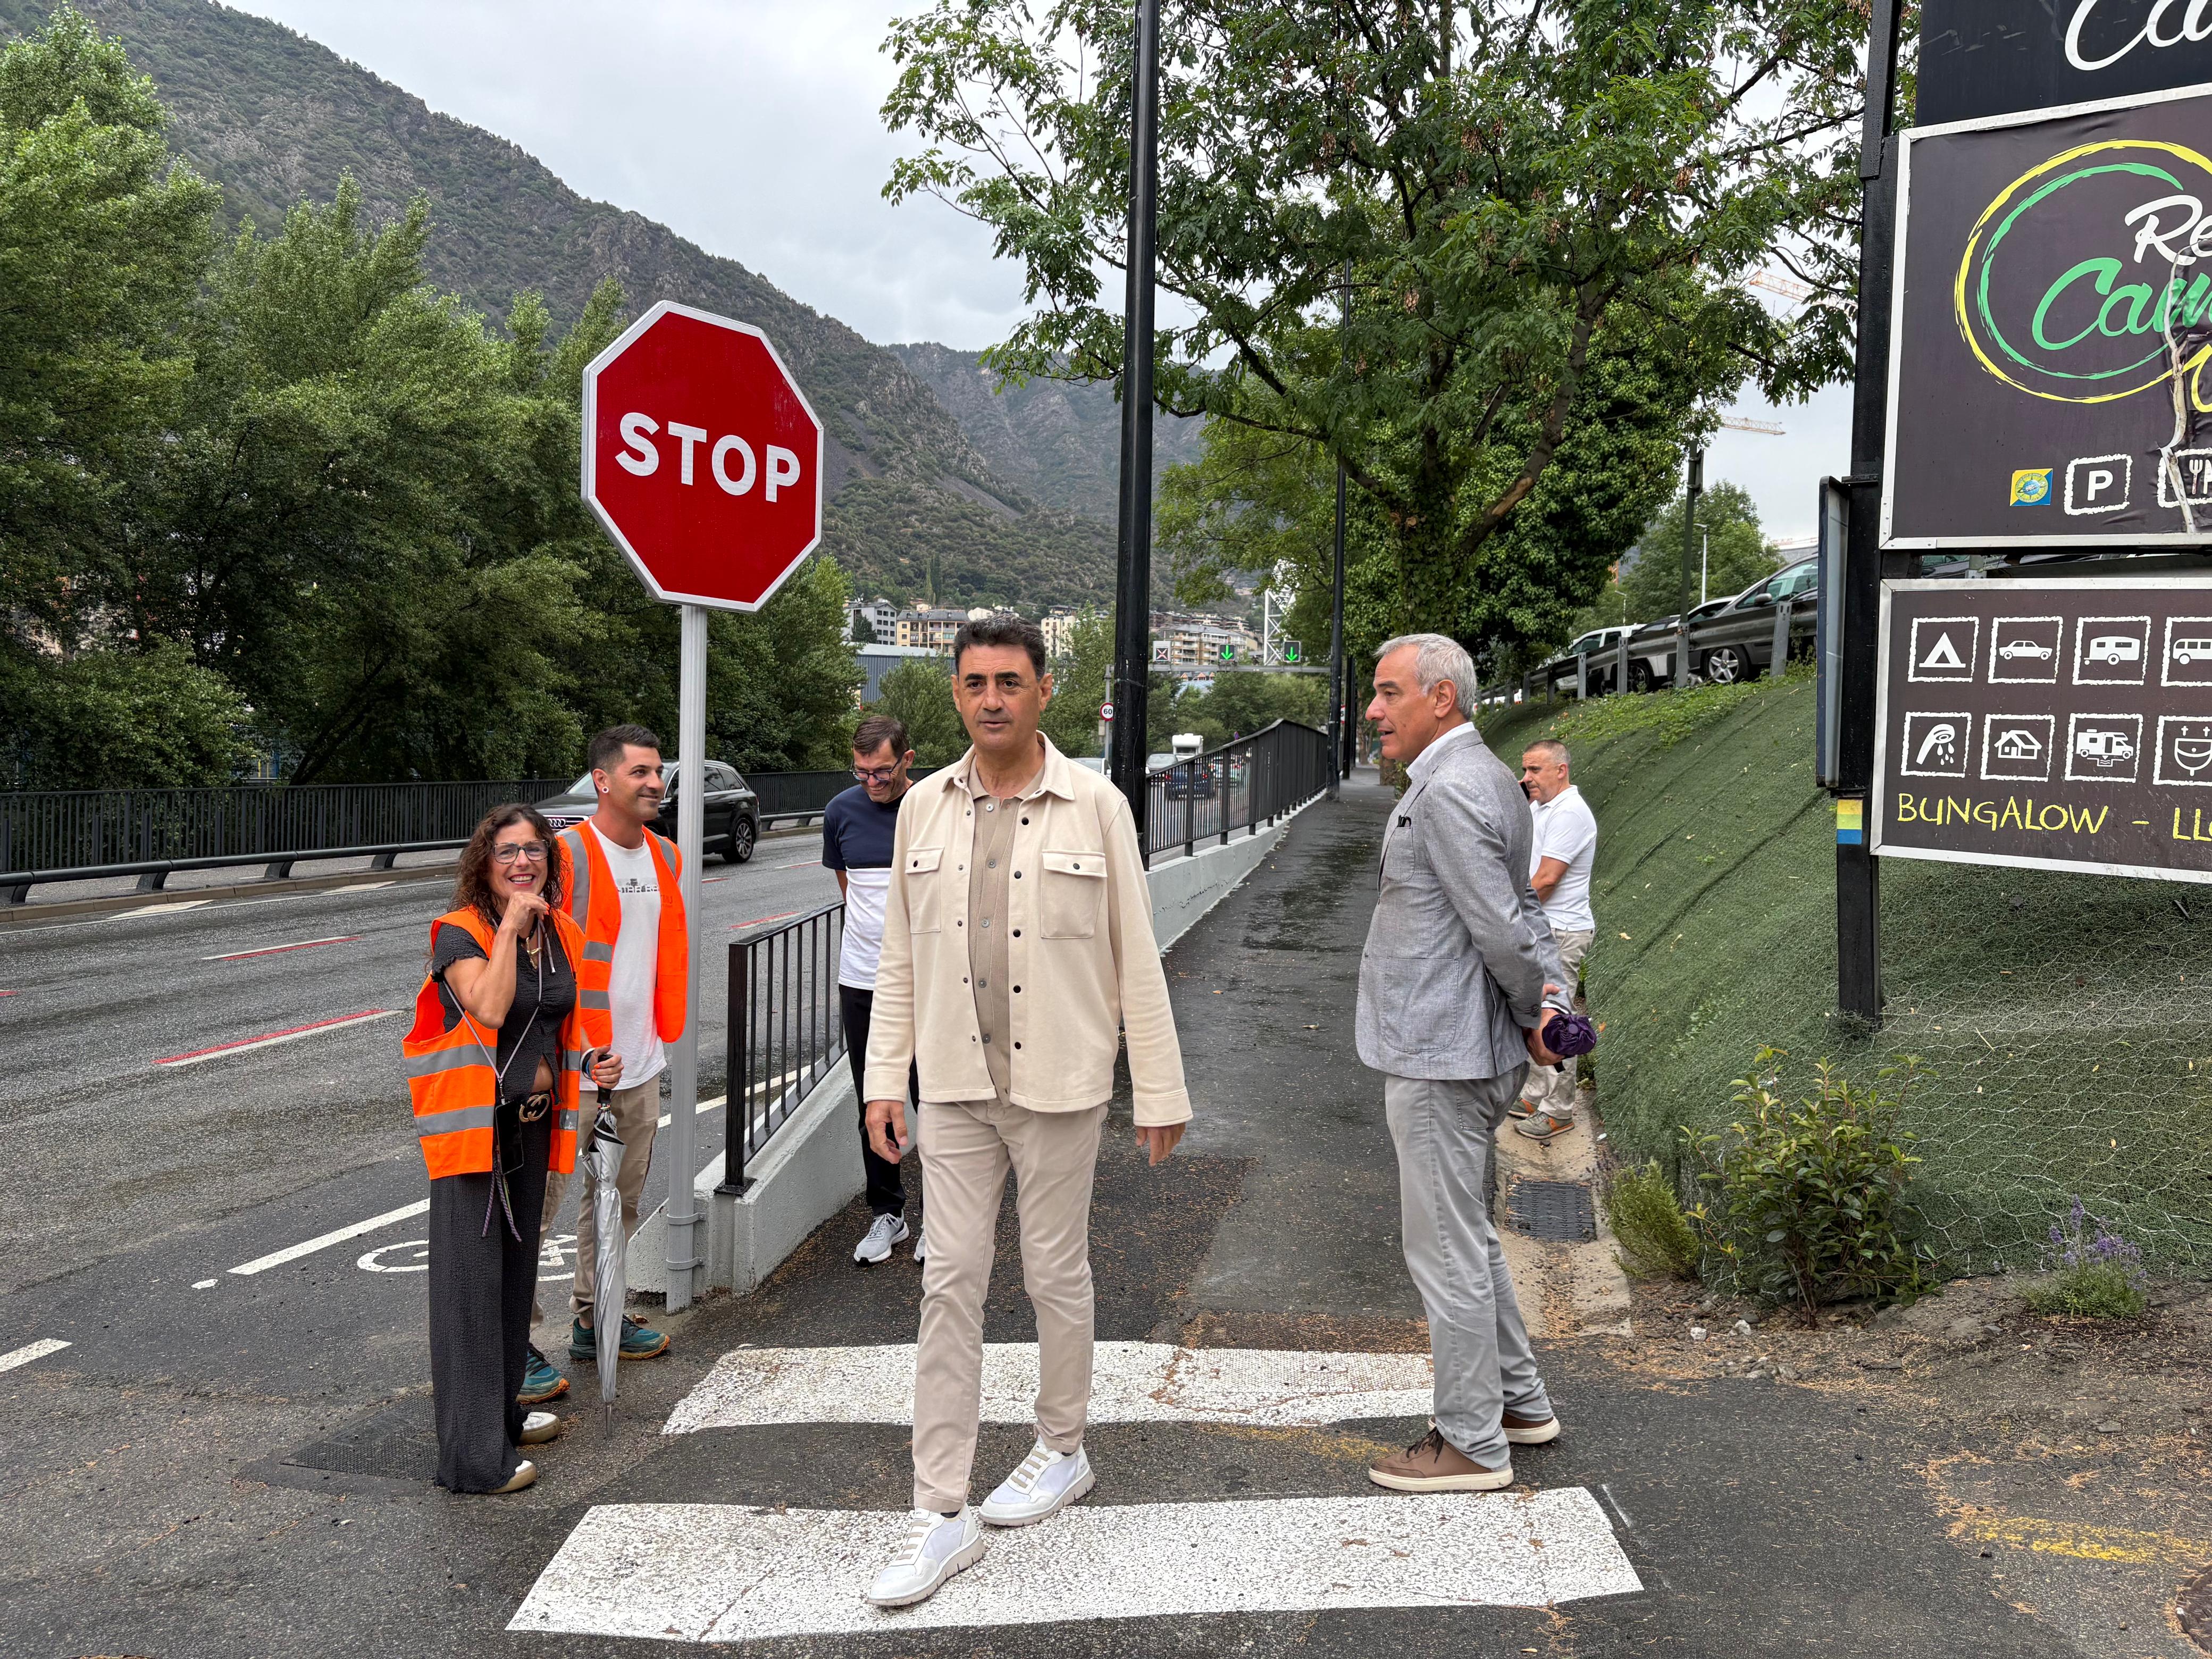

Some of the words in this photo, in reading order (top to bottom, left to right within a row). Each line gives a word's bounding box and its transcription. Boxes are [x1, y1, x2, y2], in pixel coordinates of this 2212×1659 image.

[615, 412, 800, 502] STOP
[2087, 470, 2113, 501] P
[1897, 793, 2108, 834] BUNGALOW
[2173, 807, 2212, 841] LL
